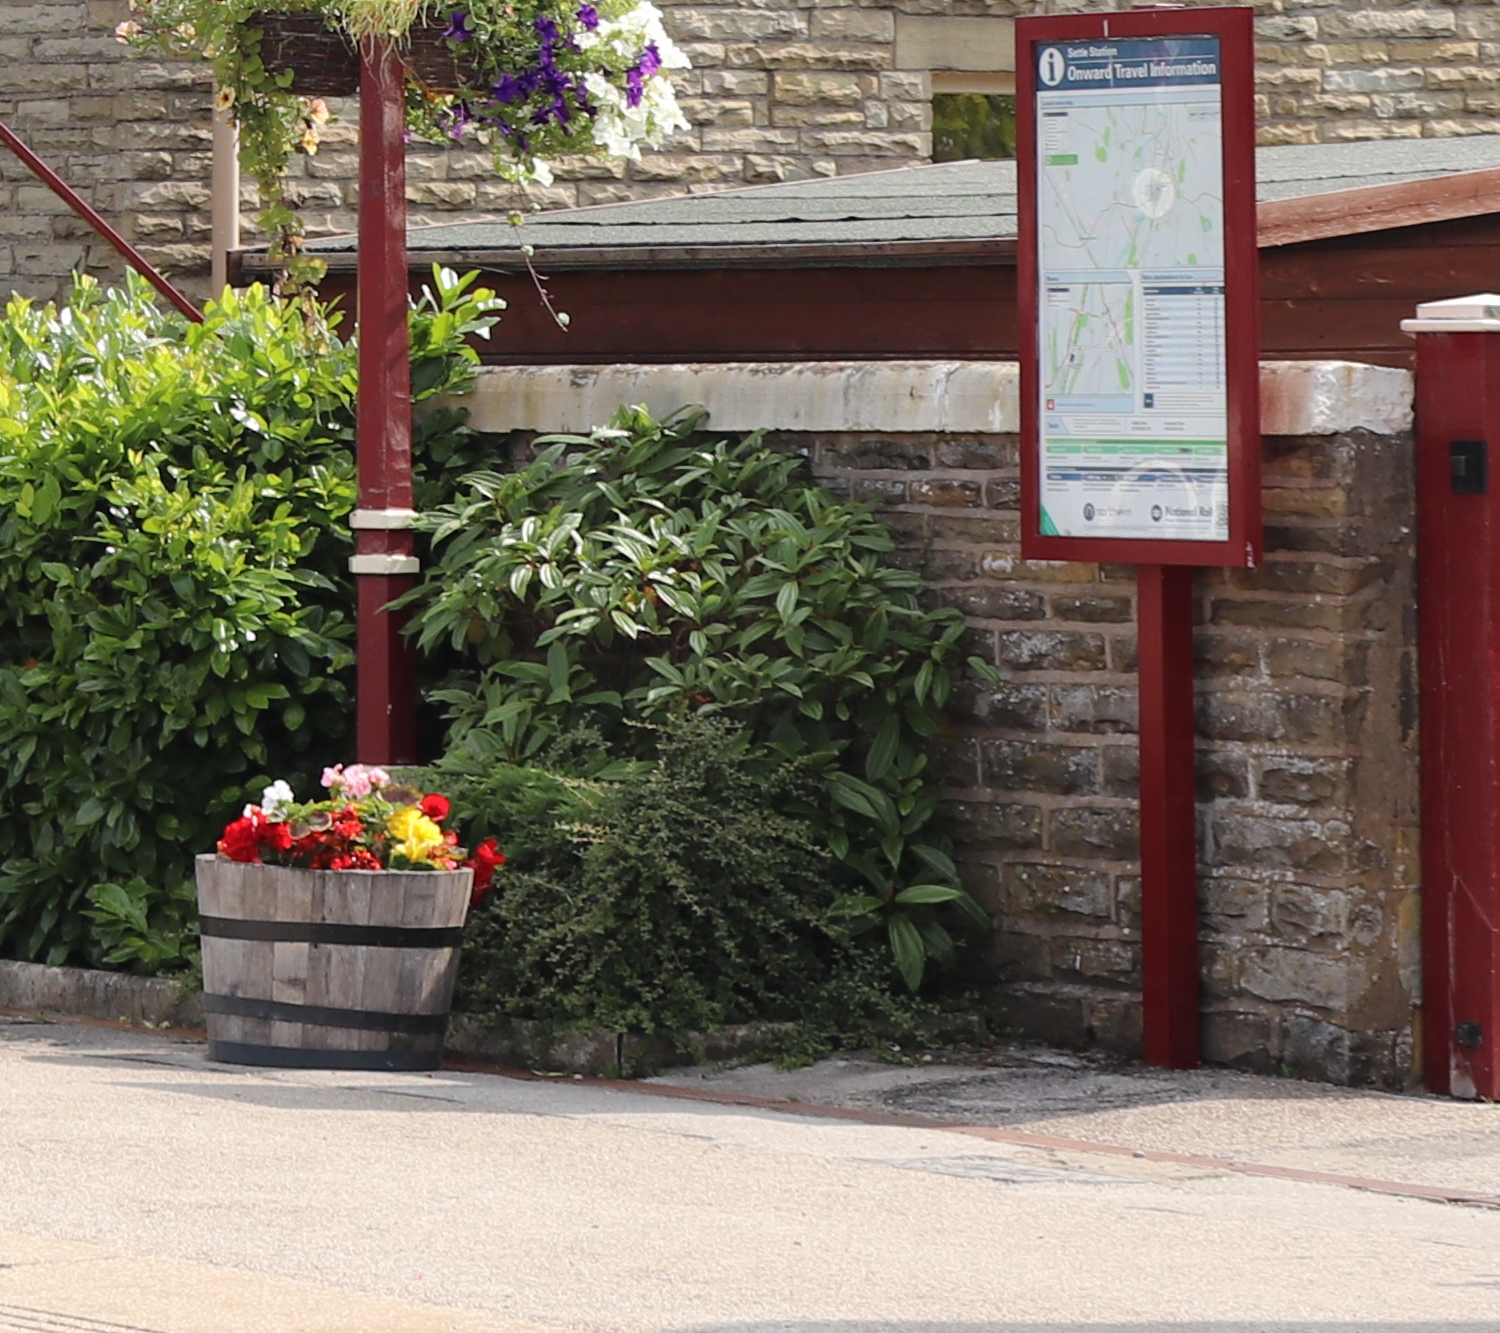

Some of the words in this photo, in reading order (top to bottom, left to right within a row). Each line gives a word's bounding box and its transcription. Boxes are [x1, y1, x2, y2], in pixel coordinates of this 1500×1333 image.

[1089, 46, 1118, 58] Station
[1067, 65, 1113, 82] Onward
[1114, 63, 1148, 80] Travel
[1150, 61, 1216, 77] Information
[1165, 505, 1197, 517] National
